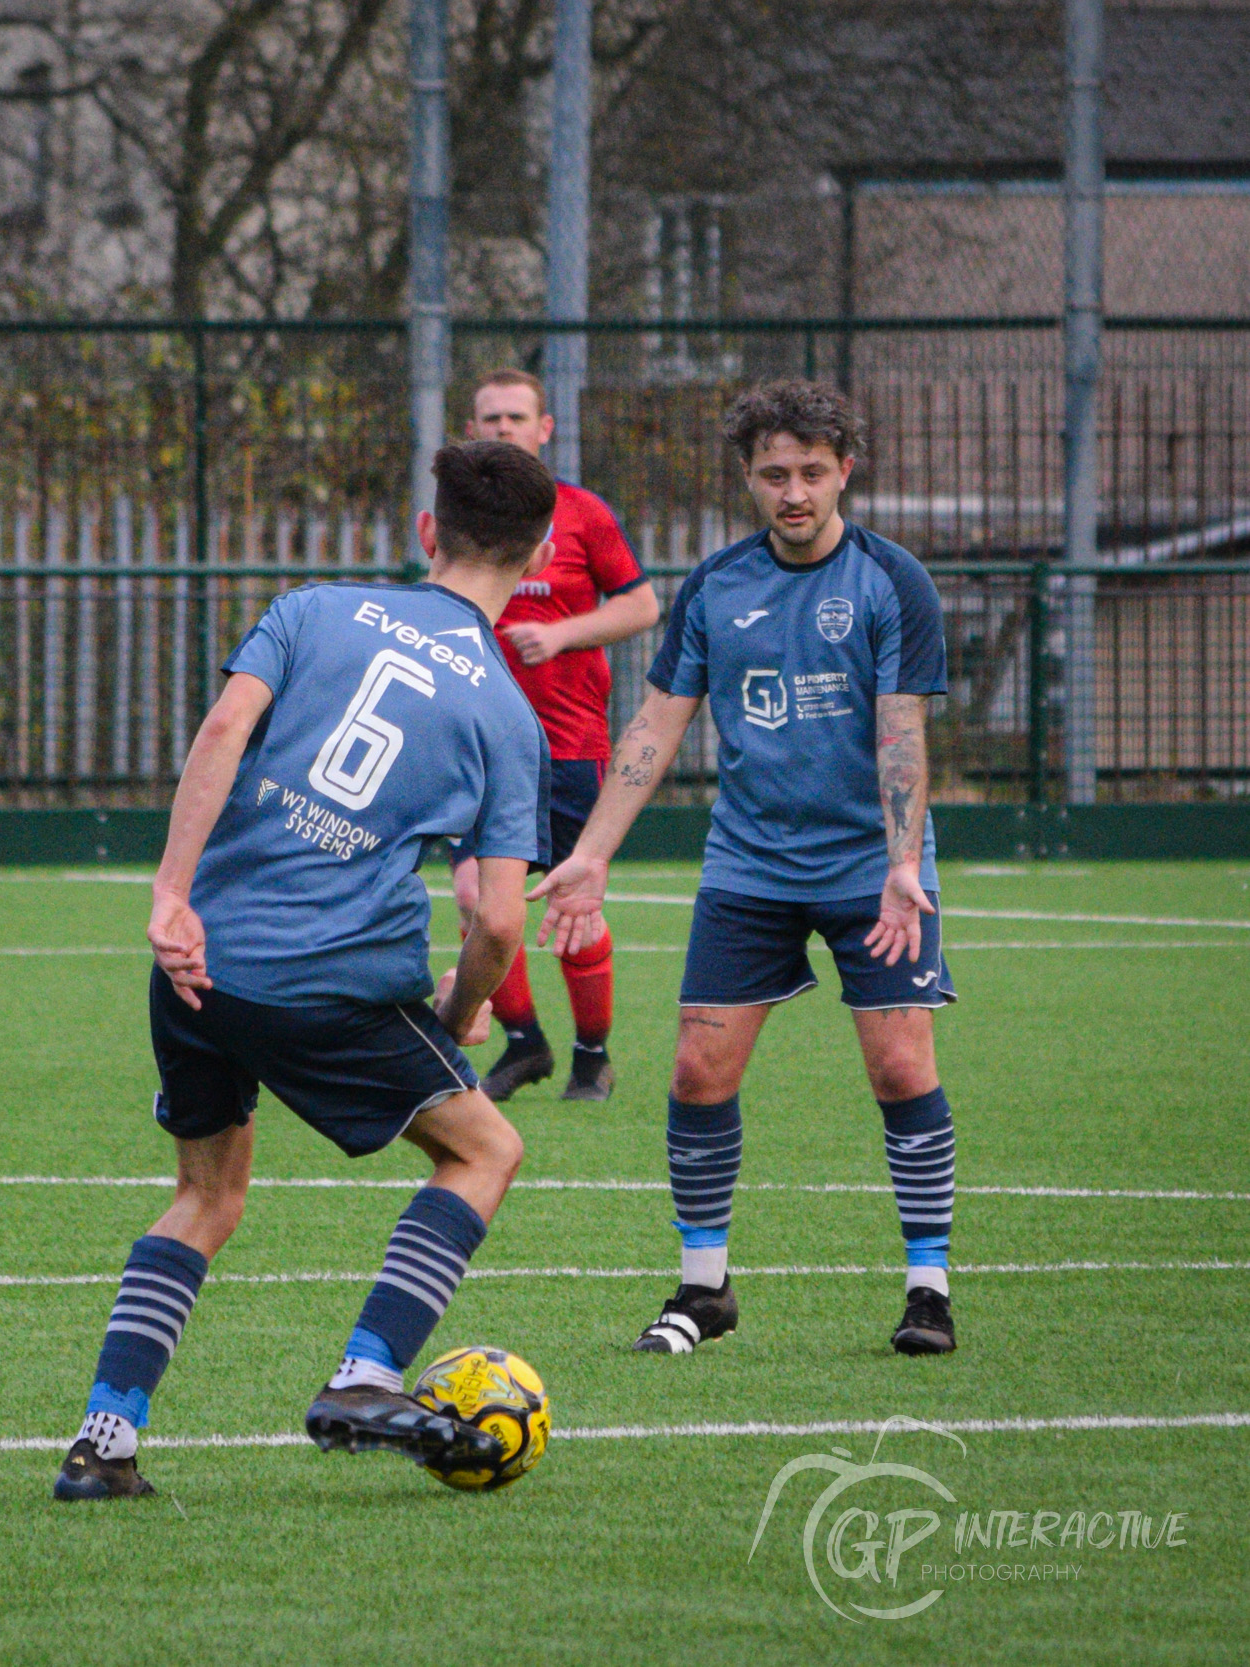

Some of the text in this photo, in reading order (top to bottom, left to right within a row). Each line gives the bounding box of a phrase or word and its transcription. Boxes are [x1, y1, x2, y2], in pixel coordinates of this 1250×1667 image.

[354, 601, 487, 687] Everest
[794, 676, 806, 686] GJ
[308, 648, 436, 811] 6
[282, 788, 381, 851] W2 WINDOW
[285, 813, 355, 861] SYSTEMS
